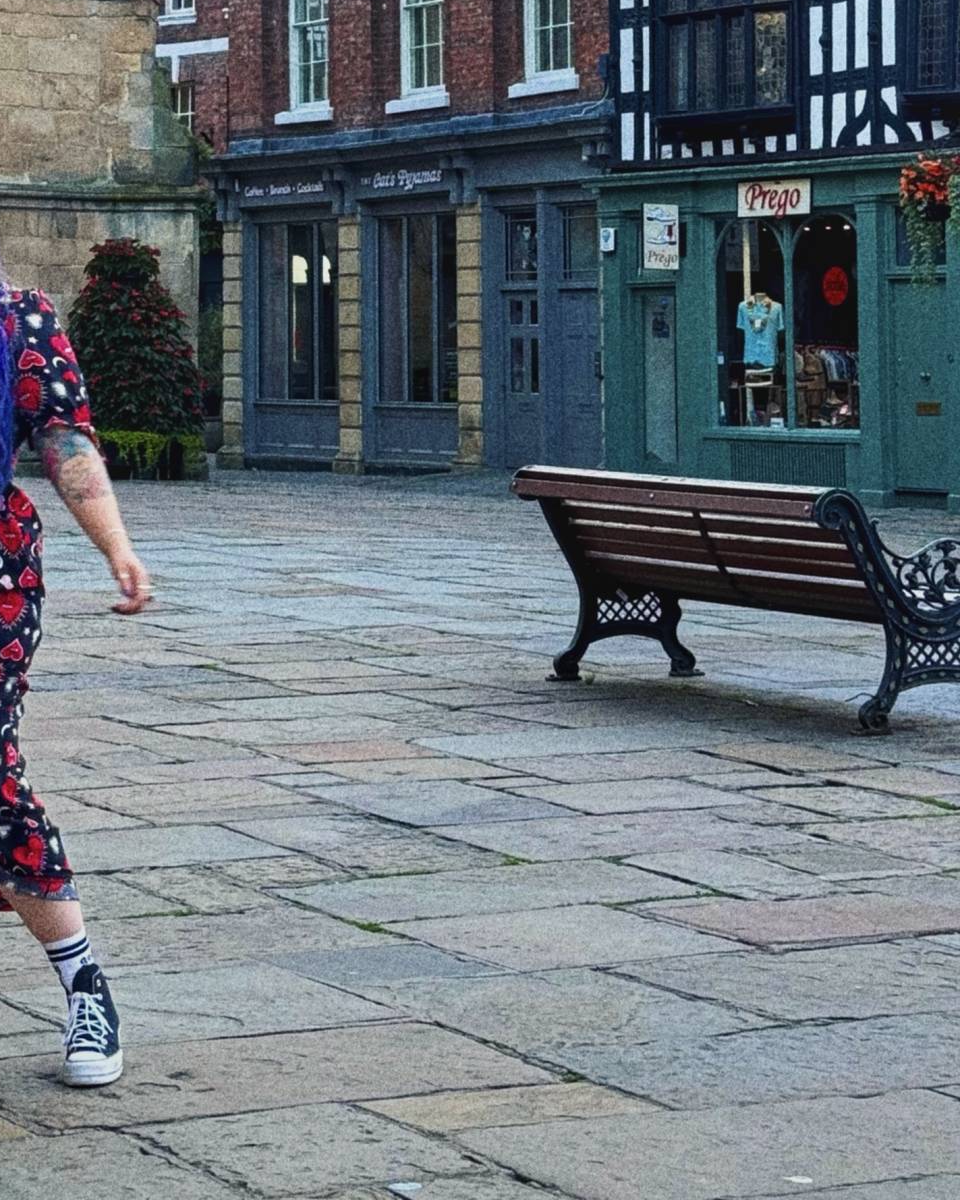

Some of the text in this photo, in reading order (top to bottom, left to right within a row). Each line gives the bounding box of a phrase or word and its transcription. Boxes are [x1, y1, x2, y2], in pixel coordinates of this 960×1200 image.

[397, 169, 442, 190] Pyjamas
[745, 183, 801, 220] Prego
[646, 249, 678, 267] Prego
